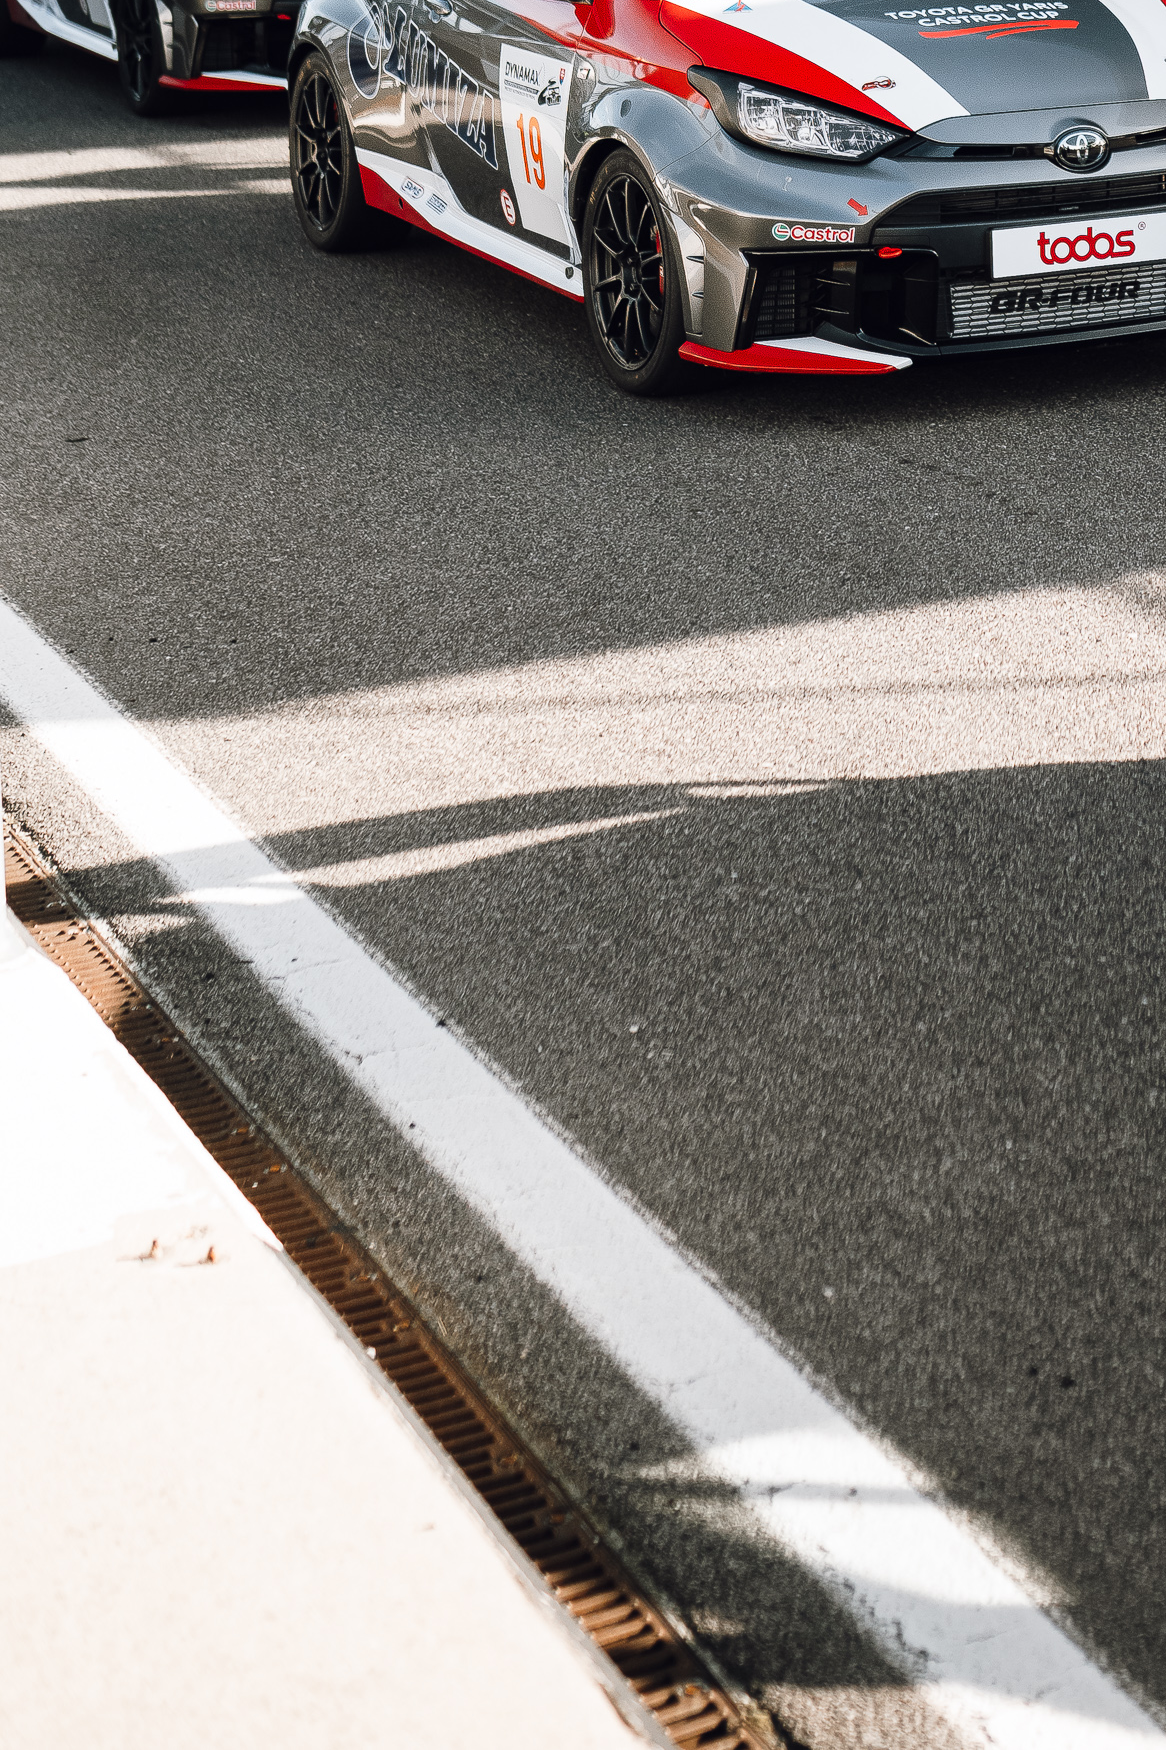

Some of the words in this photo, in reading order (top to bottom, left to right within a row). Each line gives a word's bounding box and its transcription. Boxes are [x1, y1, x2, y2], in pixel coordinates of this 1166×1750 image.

[217, 0, 256, 11] Castrol
[884, 6, 973, 20] TOYOTA
[974, 4, 1008, 13] GR
[1007, 2, 1069, 12] YARIS
[918, 12, 1016, 27] CASTROL
[1017, 10, 1060, 20] CUP
[505, 61, 540, 87] DYNAMAX
[516, 113, 546, 190] 19
[791, 226, 855, 242] Castrol
[1037, 227, 1136, 266] todos
